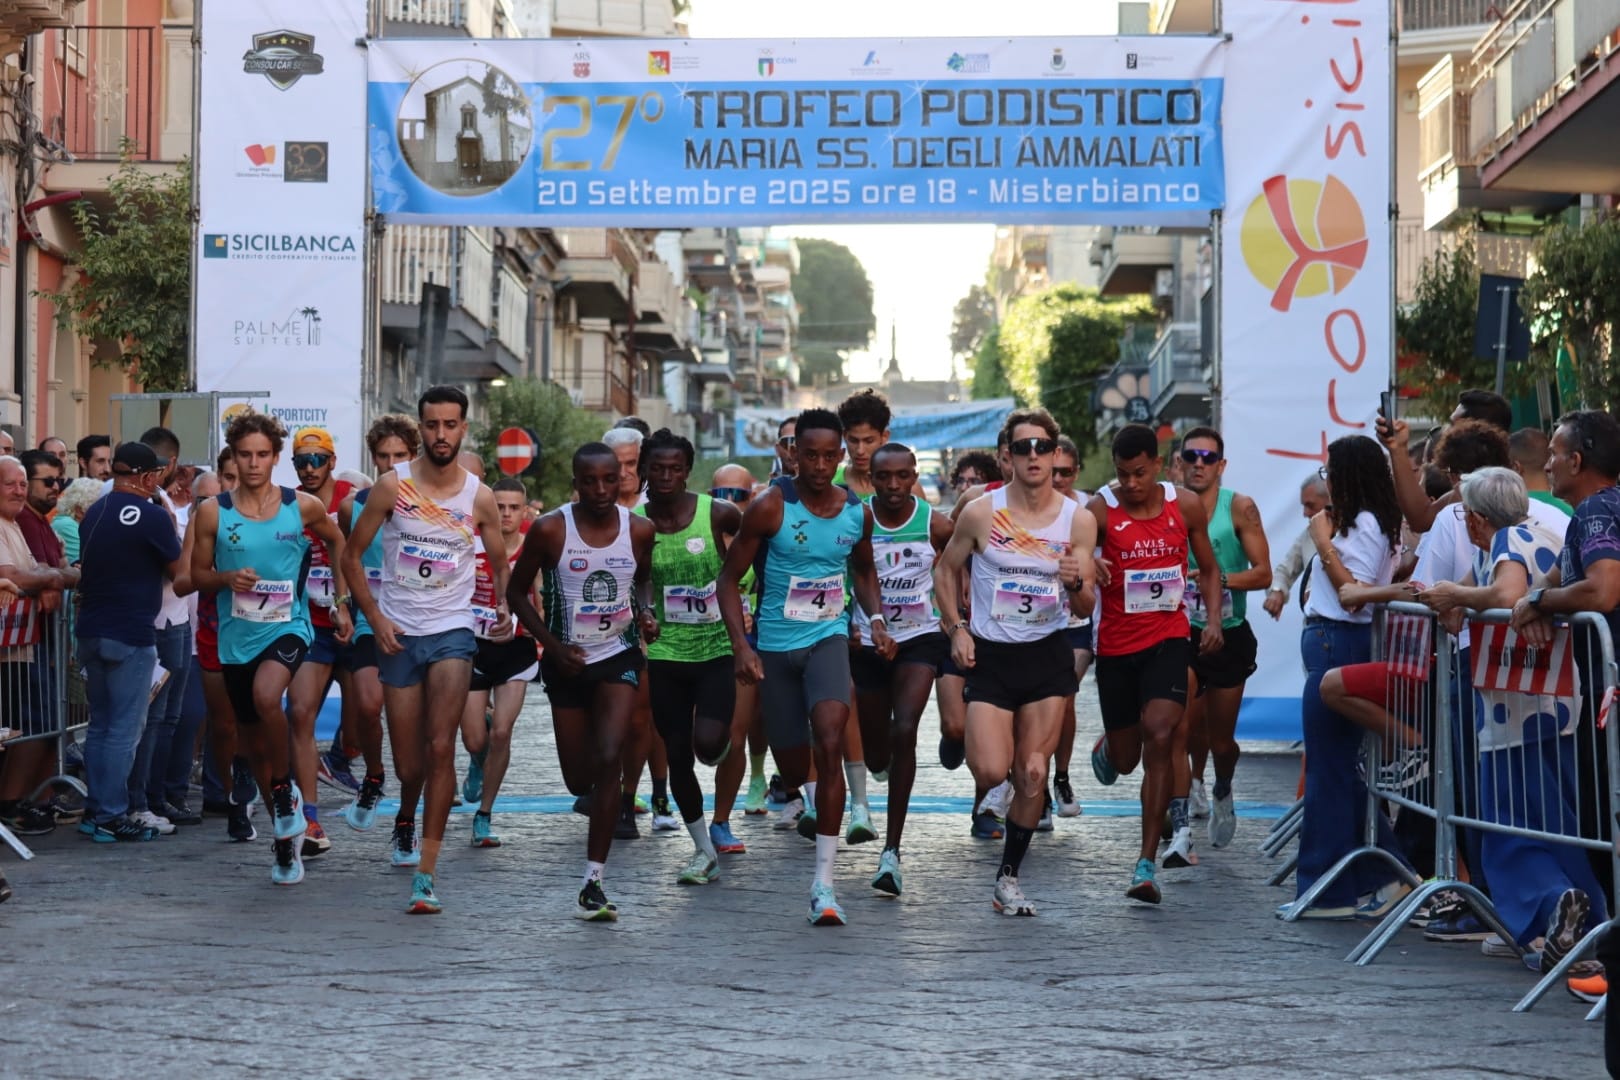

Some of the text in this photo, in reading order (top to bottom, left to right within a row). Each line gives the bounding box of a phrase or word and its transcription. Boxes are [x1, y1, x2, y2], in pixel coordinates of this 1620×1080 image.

[685, 88, 1201, 128] TROFEO PODISTICO
[684, 136, 1201, 169] MARIA SS. DEGLI AMMALATI
[538, 180, 577, 205] 20
[588, 179, 757, 205] Settembre
[768, 179, 851, 204] 2025
[862, 185, 916, 204] ore
[927, 179, 956, 204] 18
[990, 177, 1200, 204] Misterbianco
[232, 234, 355, 252] SICILBANCA
[234, 320, 301, 335] PALME
[234, 336, 302, 345] SUITES
[271, 408, 328, 421] SPORTCITY
[1134, 538, 1168, 550] A.V.I.S.
[419, 549, 454, 561] KARHU
[1121, 547, 1180, 559] BARLETTA
[419, 560, 432, 578] 6
[1147, 570, 1180, 581] KARHU
[255, 583, 289, 592] KARHU
[687, 583, 714, 598] KARHU
[813, 579, 841, 589] KARHU
[1018, 584, 1053, 595] KARHU
[1150, 582, 1163, 599] 9
[257, 593, 270, 610] 7
[598, 600, 629, 613] KARHU
[683, 597, 707, 614] 10
[811, 590, 826, 610] 4
[887, 594, 921, 604] KARHU
[1018, 594, 1033, 614] 3
[889, 604, 902, 622] 2
[598, 614, 611, 632] 5
